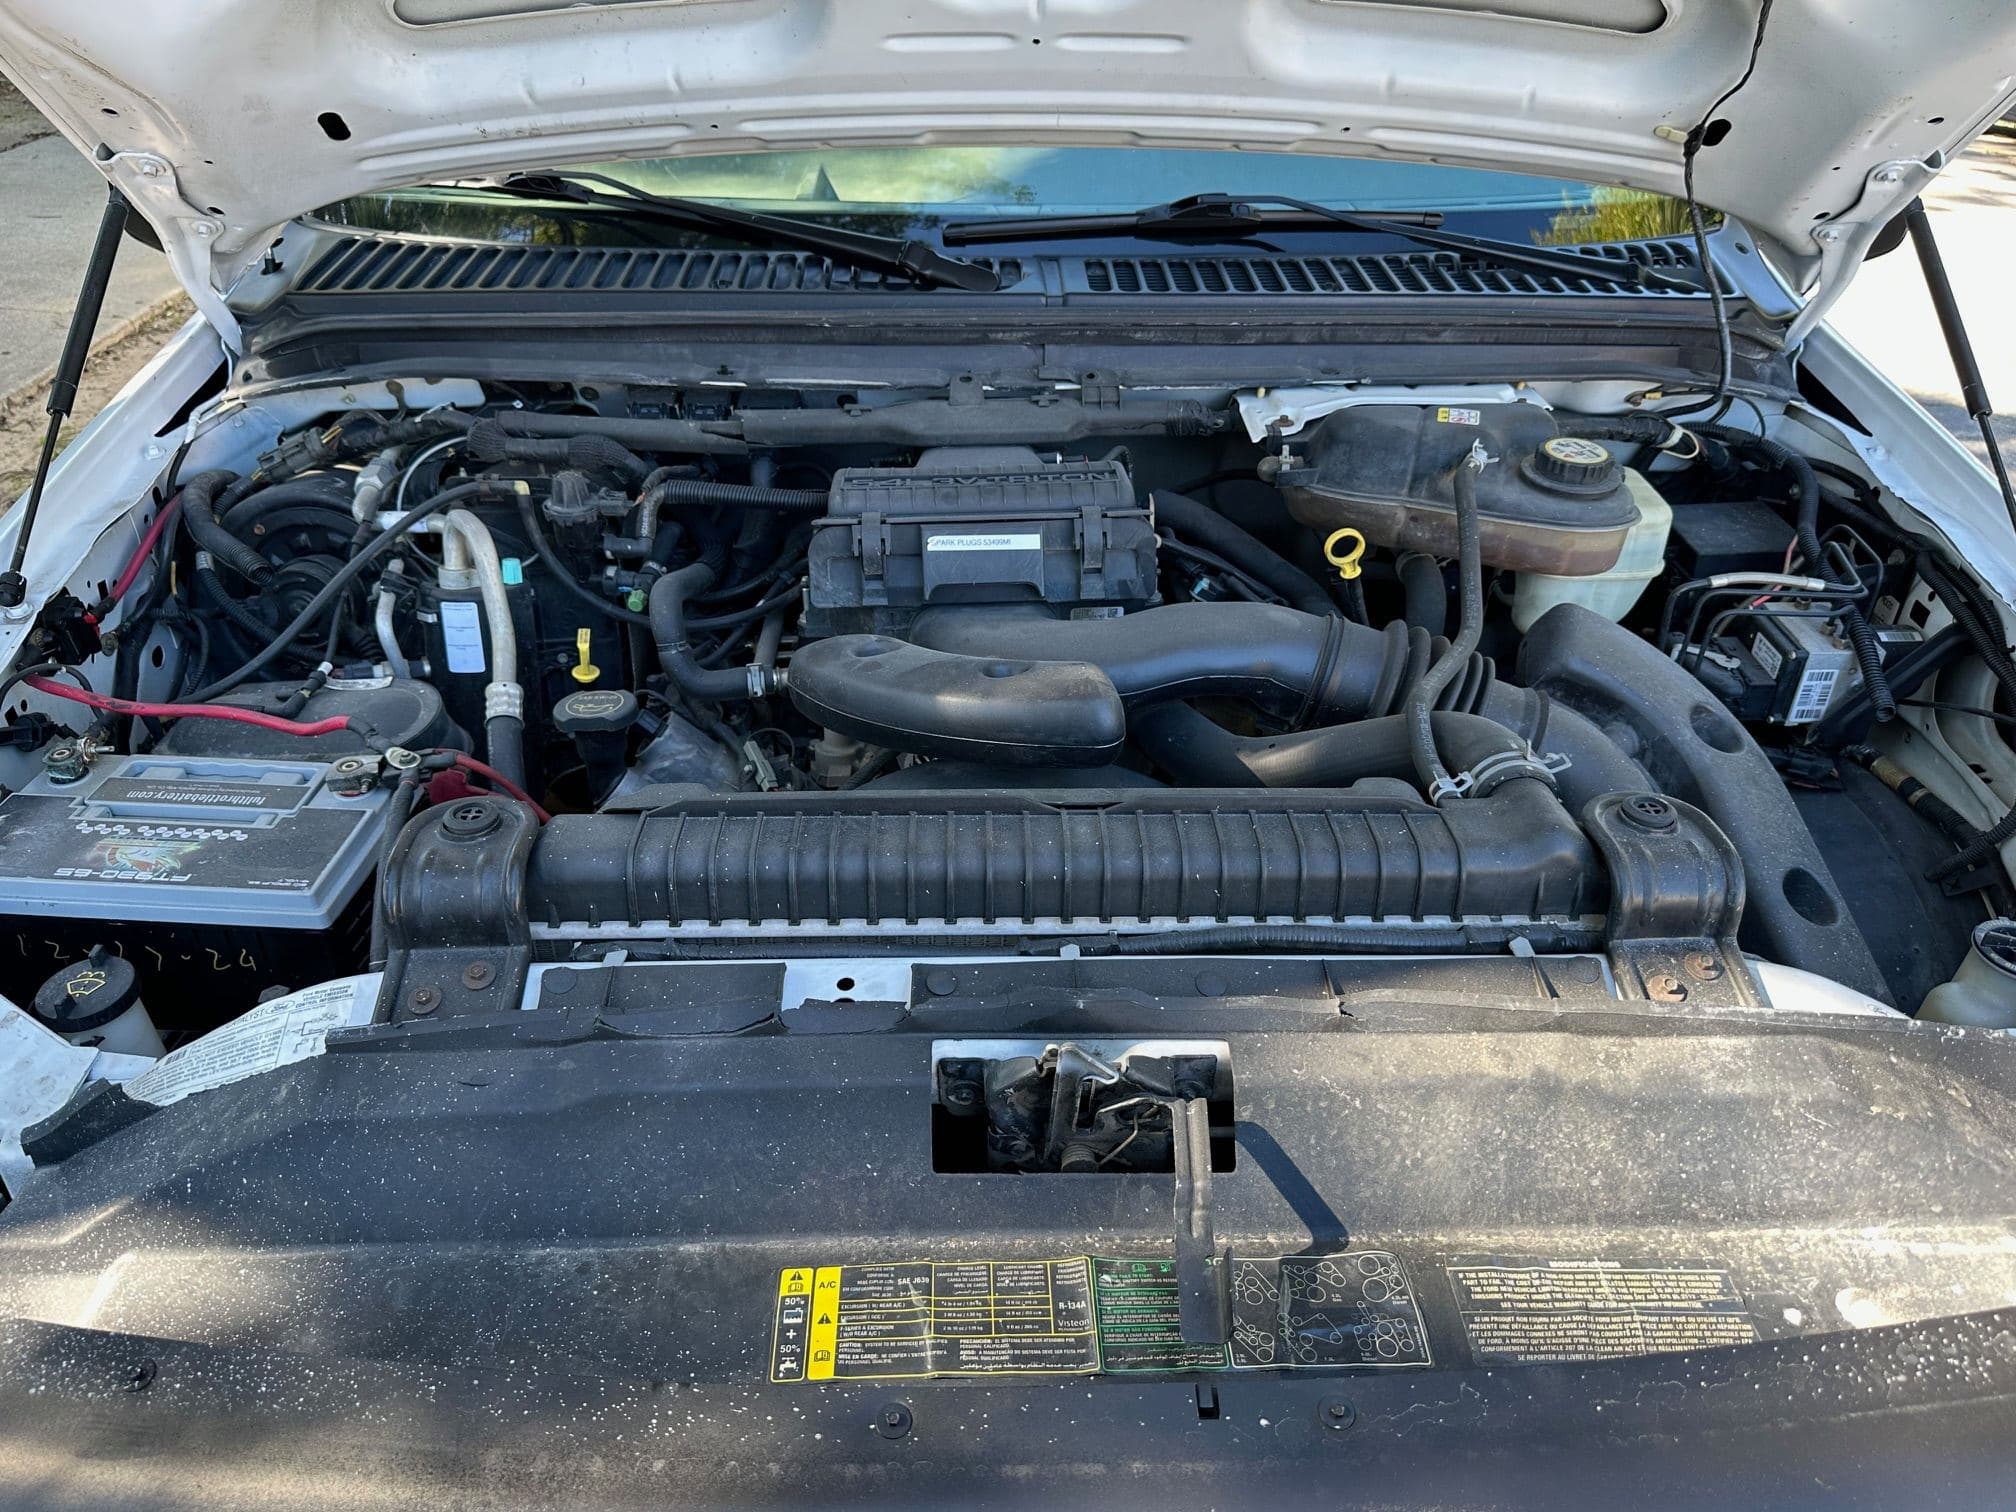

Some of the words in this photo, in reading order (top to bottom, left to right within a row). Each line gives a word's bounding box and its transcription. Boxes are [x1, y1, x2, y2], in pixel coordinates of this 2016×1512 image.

[986, 472, 1111, 485] TRITON
[957, 538, 982, 546] PLUGS
[126, 790, 267, 805] fullthrottlebattery.com
[54, 867, 192, 882] FT930-65
[784, 1297, 804, 1305] 50%
[1058, 1300, 1086, 1310] R-134A
[1058, 1318, 1090, 1327] Visteon
[780, 1344, 800, 1352] 50%
